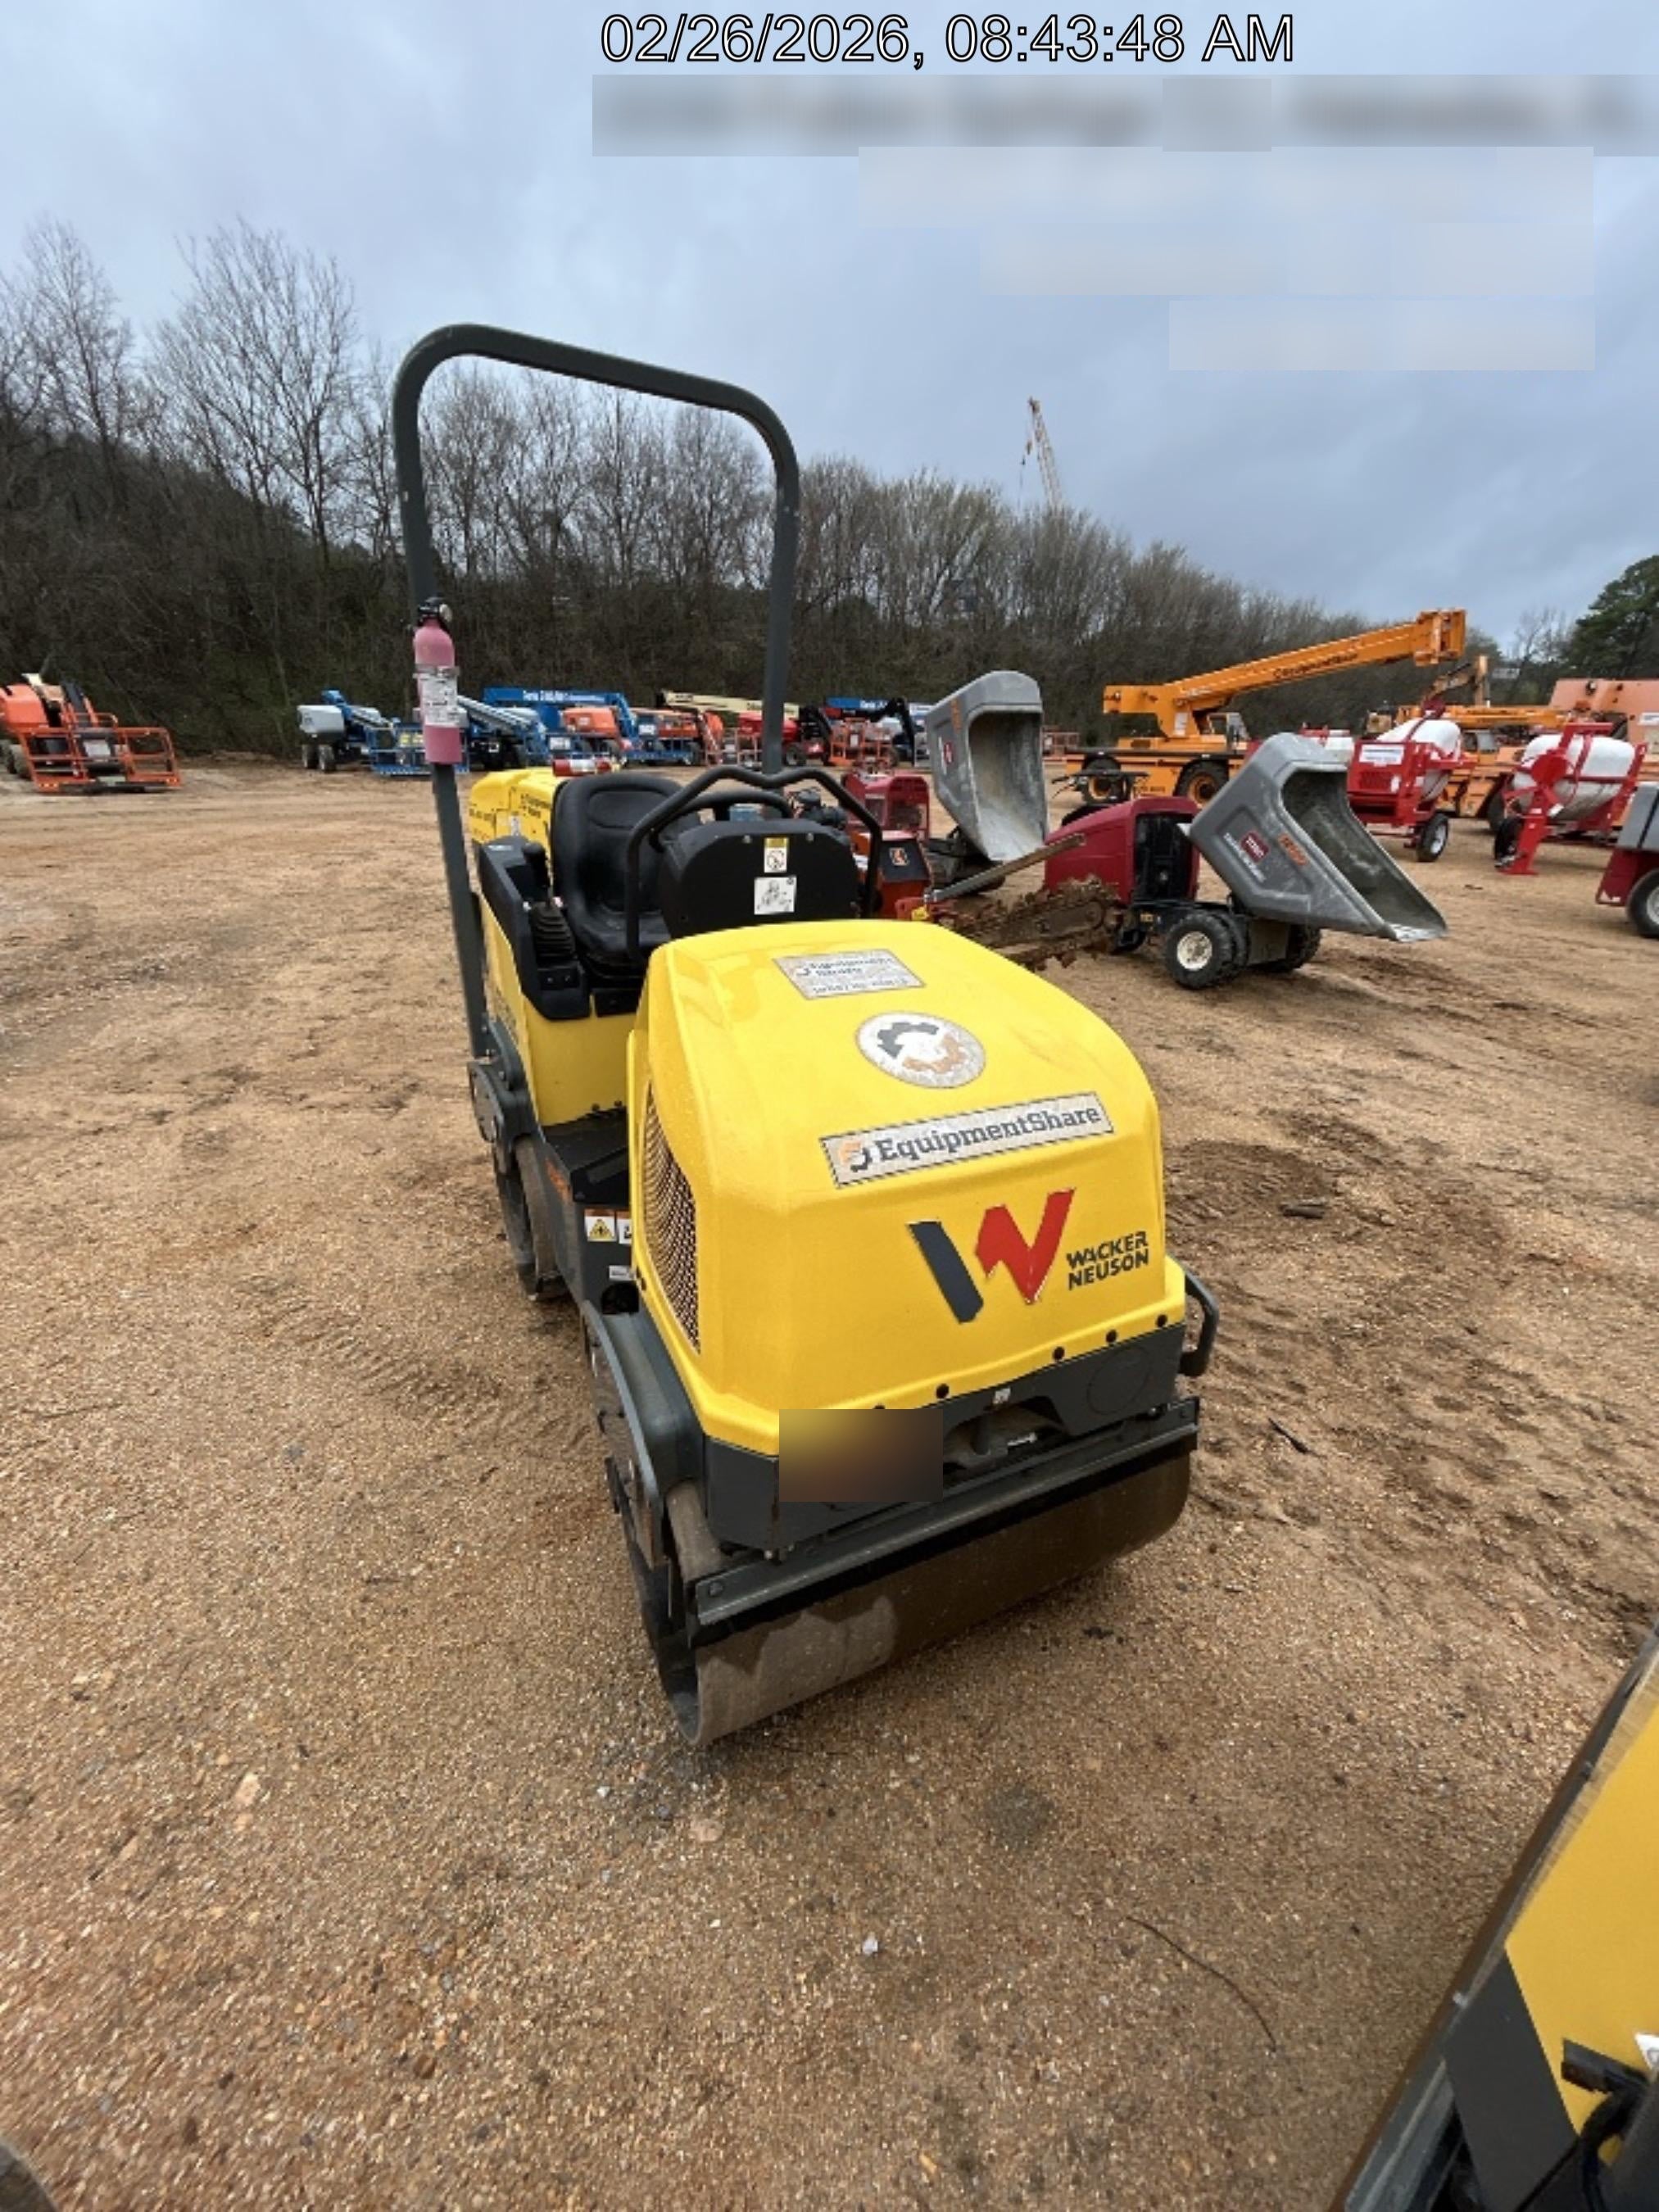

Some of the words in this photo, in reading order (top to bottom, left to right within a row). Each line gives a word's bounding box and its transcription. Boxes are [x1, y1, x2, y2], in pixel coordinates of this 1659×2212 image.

[875, 1107, 1102, 1162] EquipmentShare
[1066, 1231, 1149, 1270] WACKER
[1067, 1249, 1149, 1291] NEUSON
